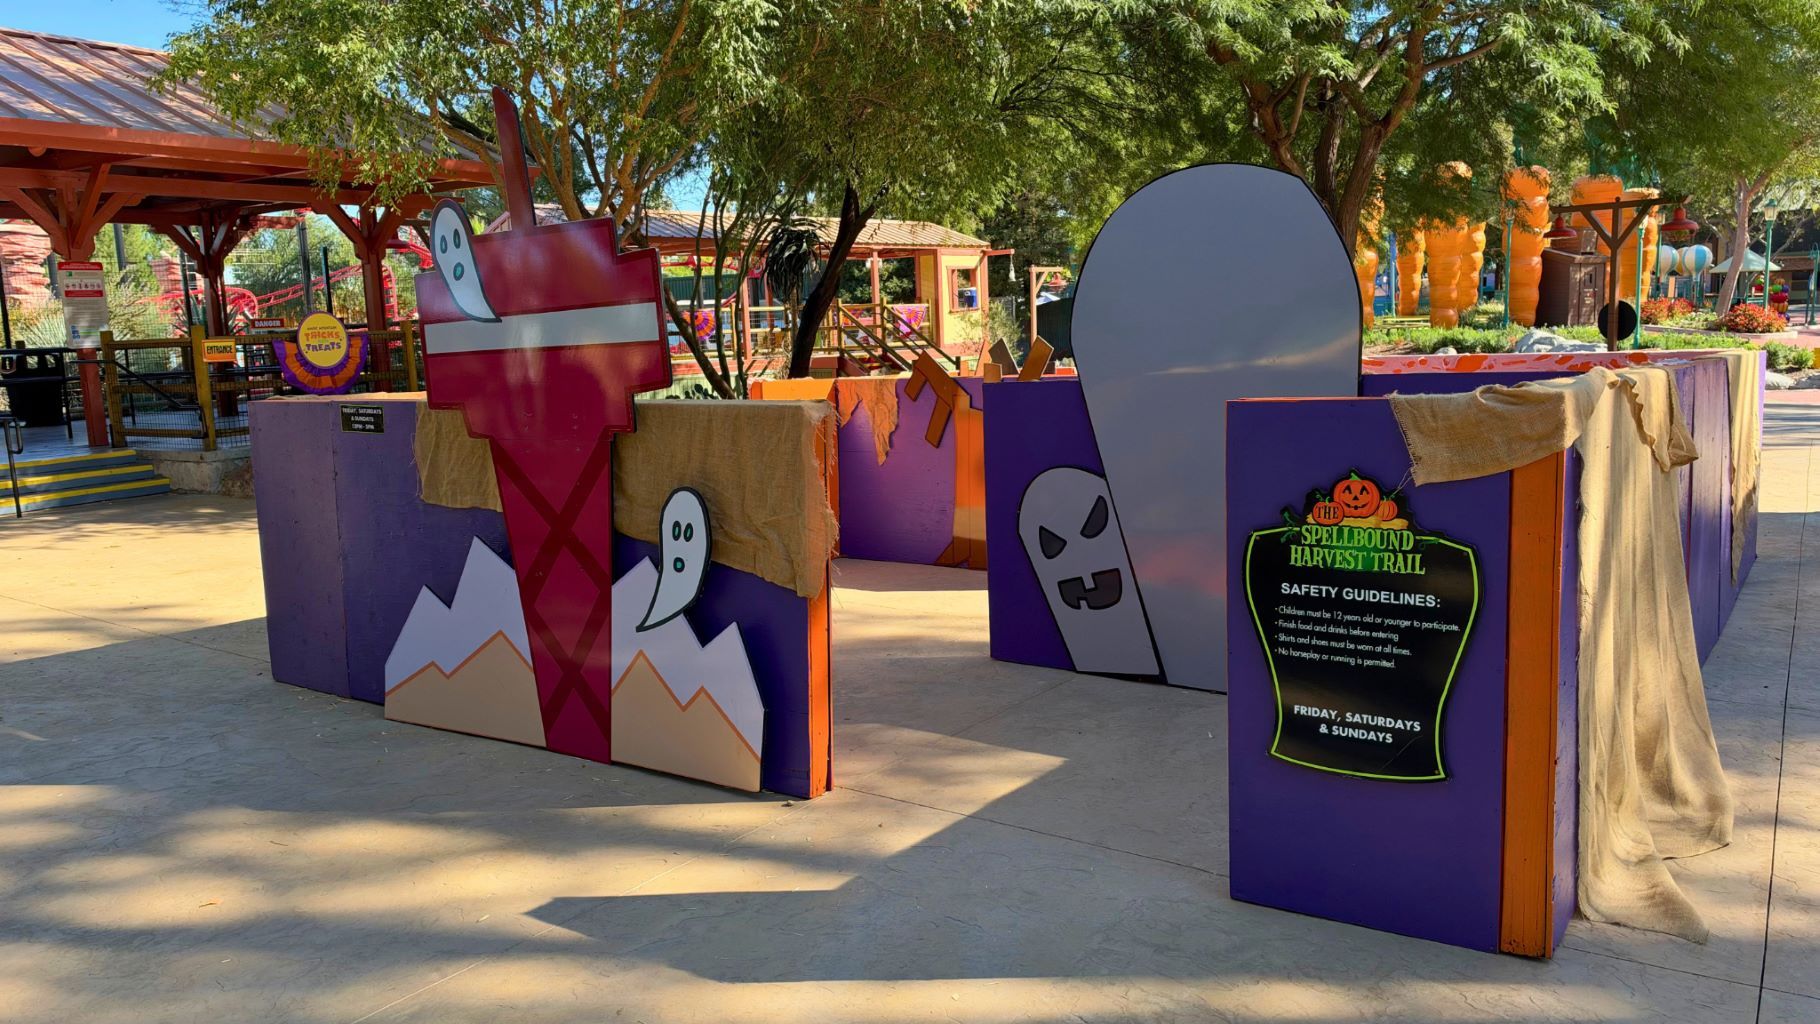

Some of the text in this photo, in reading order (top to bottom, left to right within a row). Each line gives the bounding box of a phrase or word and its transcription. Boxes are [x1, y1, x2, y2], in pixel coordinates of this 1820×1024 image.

[304, 331, 340, 342] TRICKS
[306, 342, 342, 352] TREATS
[206, 344, 233, 354] ENTRANCE
[1316, 506, 1338, 520] THE
[1301, 524, 1414, 551] SPELLBOUND
[1289, 545, 1426, 574] HARVEST TRAIL
[1281, 582, 1440, 608] SAFETY GUIDELINES:
[1278, 605, 1305, 616] Children
[1306, 610, 1321, 618] must
[1322, 609, 1331, 618] be
[1333, 610, 1342, 620] 12
[1362, 613, 1374, 623] old
[1384, 618, 1412, 628] younger
[1422, 621, 1460, 632] participate.
[1278, 620, 1399, 642] Finish food and drinks before entering
[1278, 632, 1296, 643] Shirts
[1297, 635, 1309, 644] and
[1311, 636, 1328, 646] shoes
[1346, 640, 1355, 649] be
[1383, 644, 1392, 653] all
[1393, 646, 1412, 656] times.
[1278, 647, 1289, 655] No
[1290, 647, 1320, 661] horseplay
[1330, 655, 1356, 665] running
[1357, 656, 1362, 664] is
[1364, 658, 1396, 668] permitted.
[1294, 704, 1421, 732] FRIDAY, SATURDAYS
[1319, 724, 1393, 743] & SUNDAYS
